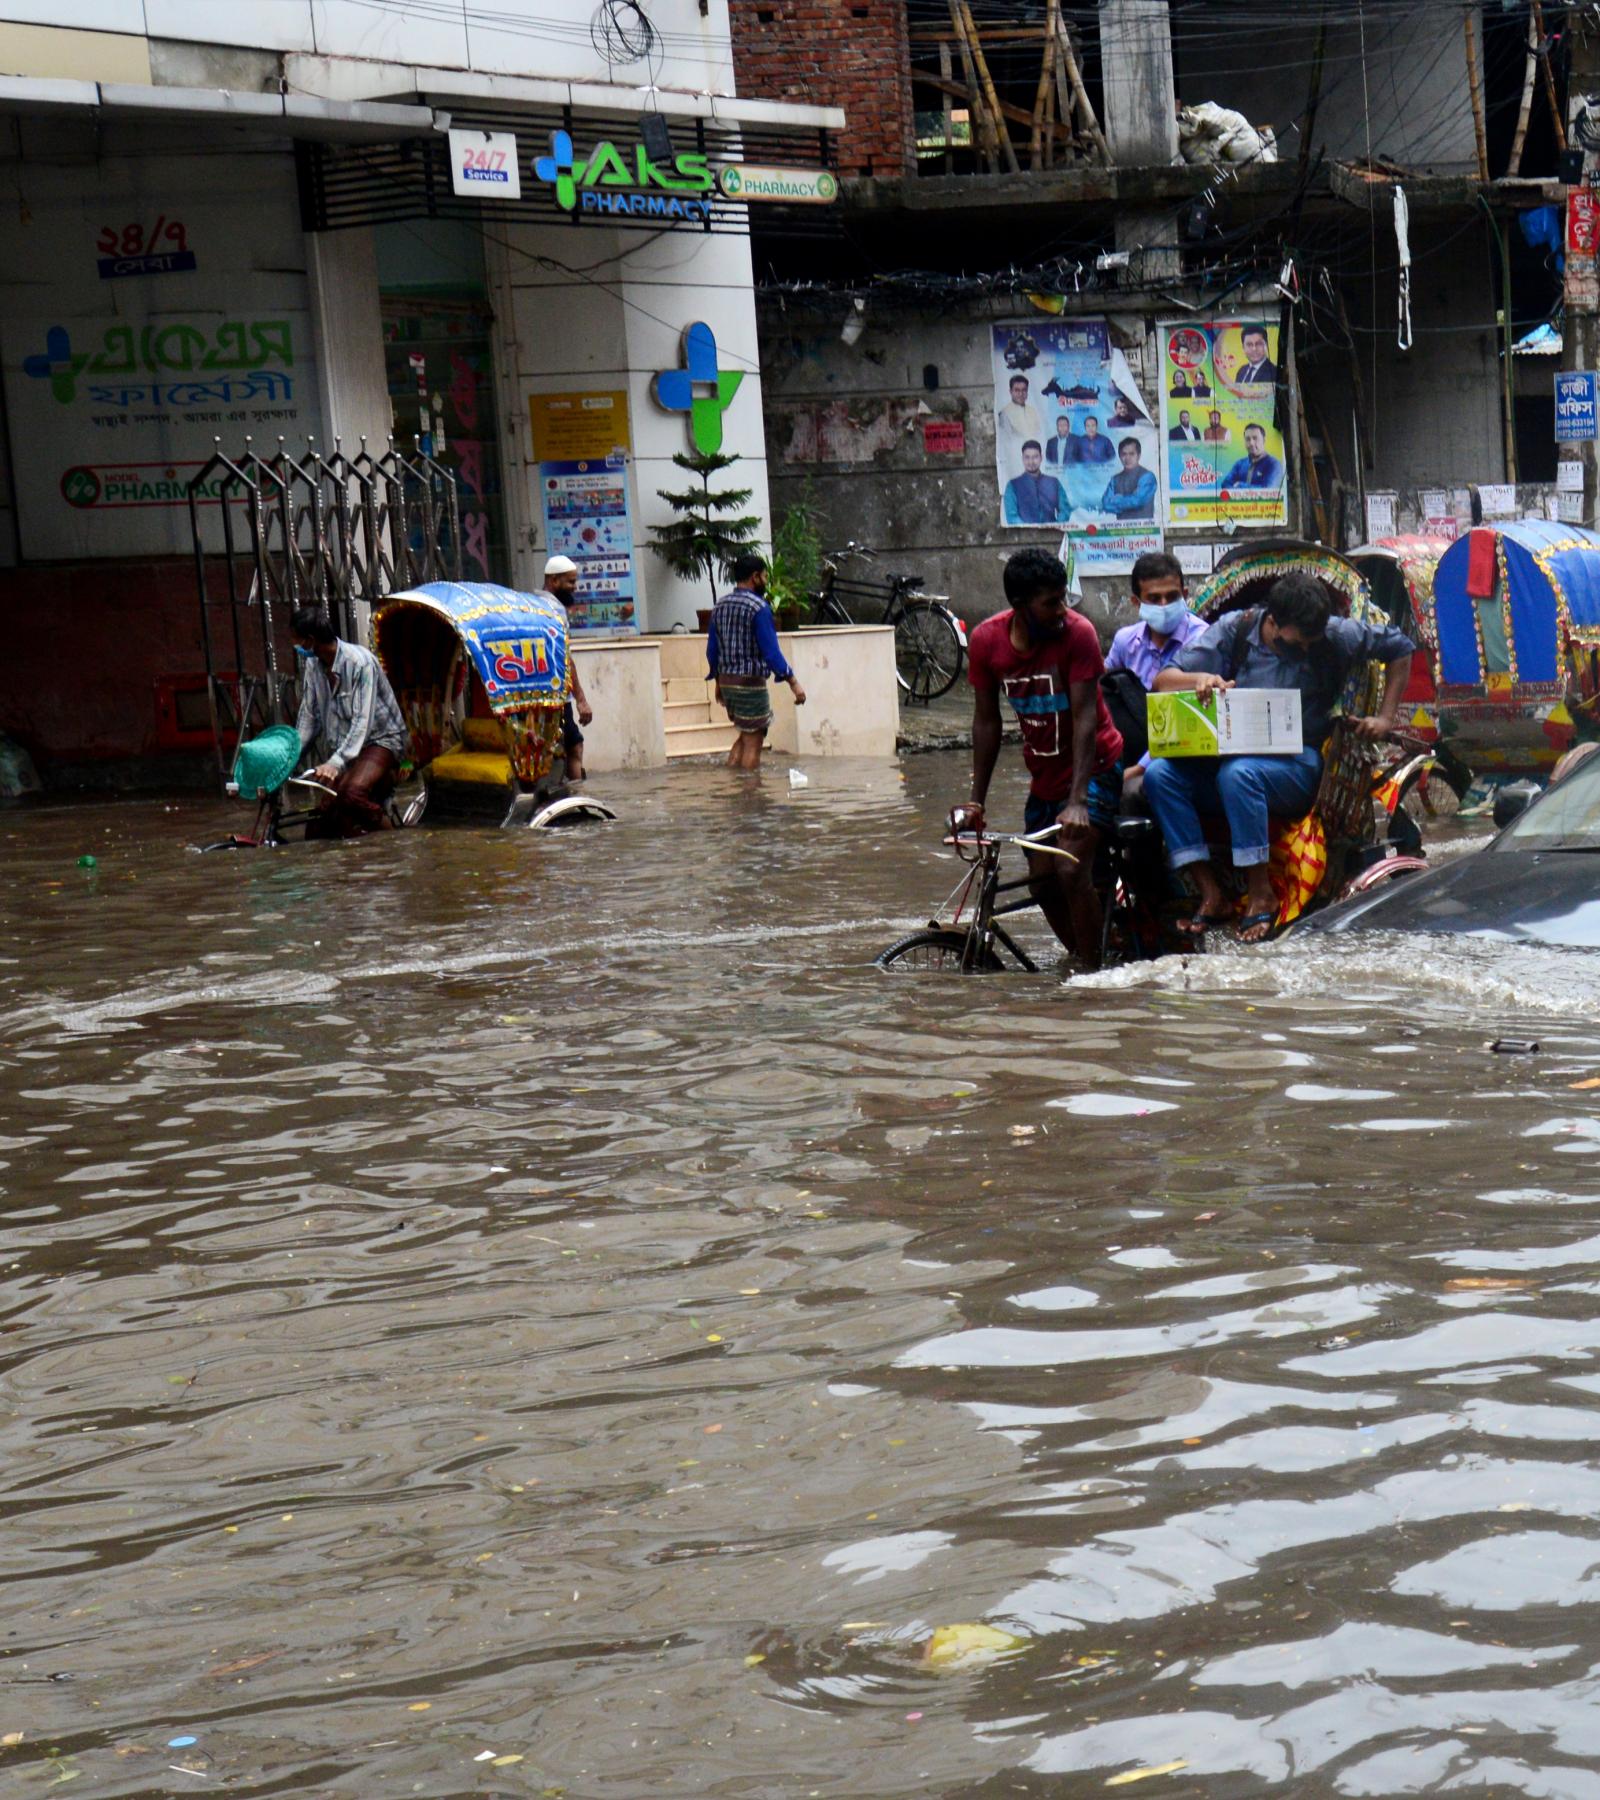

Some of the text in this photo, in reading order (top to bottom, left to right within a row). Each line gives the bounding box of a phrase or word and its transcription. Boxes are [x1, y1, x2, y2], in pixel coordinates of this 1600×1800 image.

[463, 147, 507, 170] 24/7
[465, 168, 506, 183] Service
[744, 179, 816, 197] PHARMACY
[581, 190, 714, 221] PHARMACY
[97, 215, 188, 257] ২৪/৭
[113, 255, 175, 275] সেবা
[1560, 377, 1590, 398] কাজী
[1558, 397, 1594, 416] অফিস
[104, 472, 141, 483] MODEL
[104, 477, 242, 503] PHARMACY
